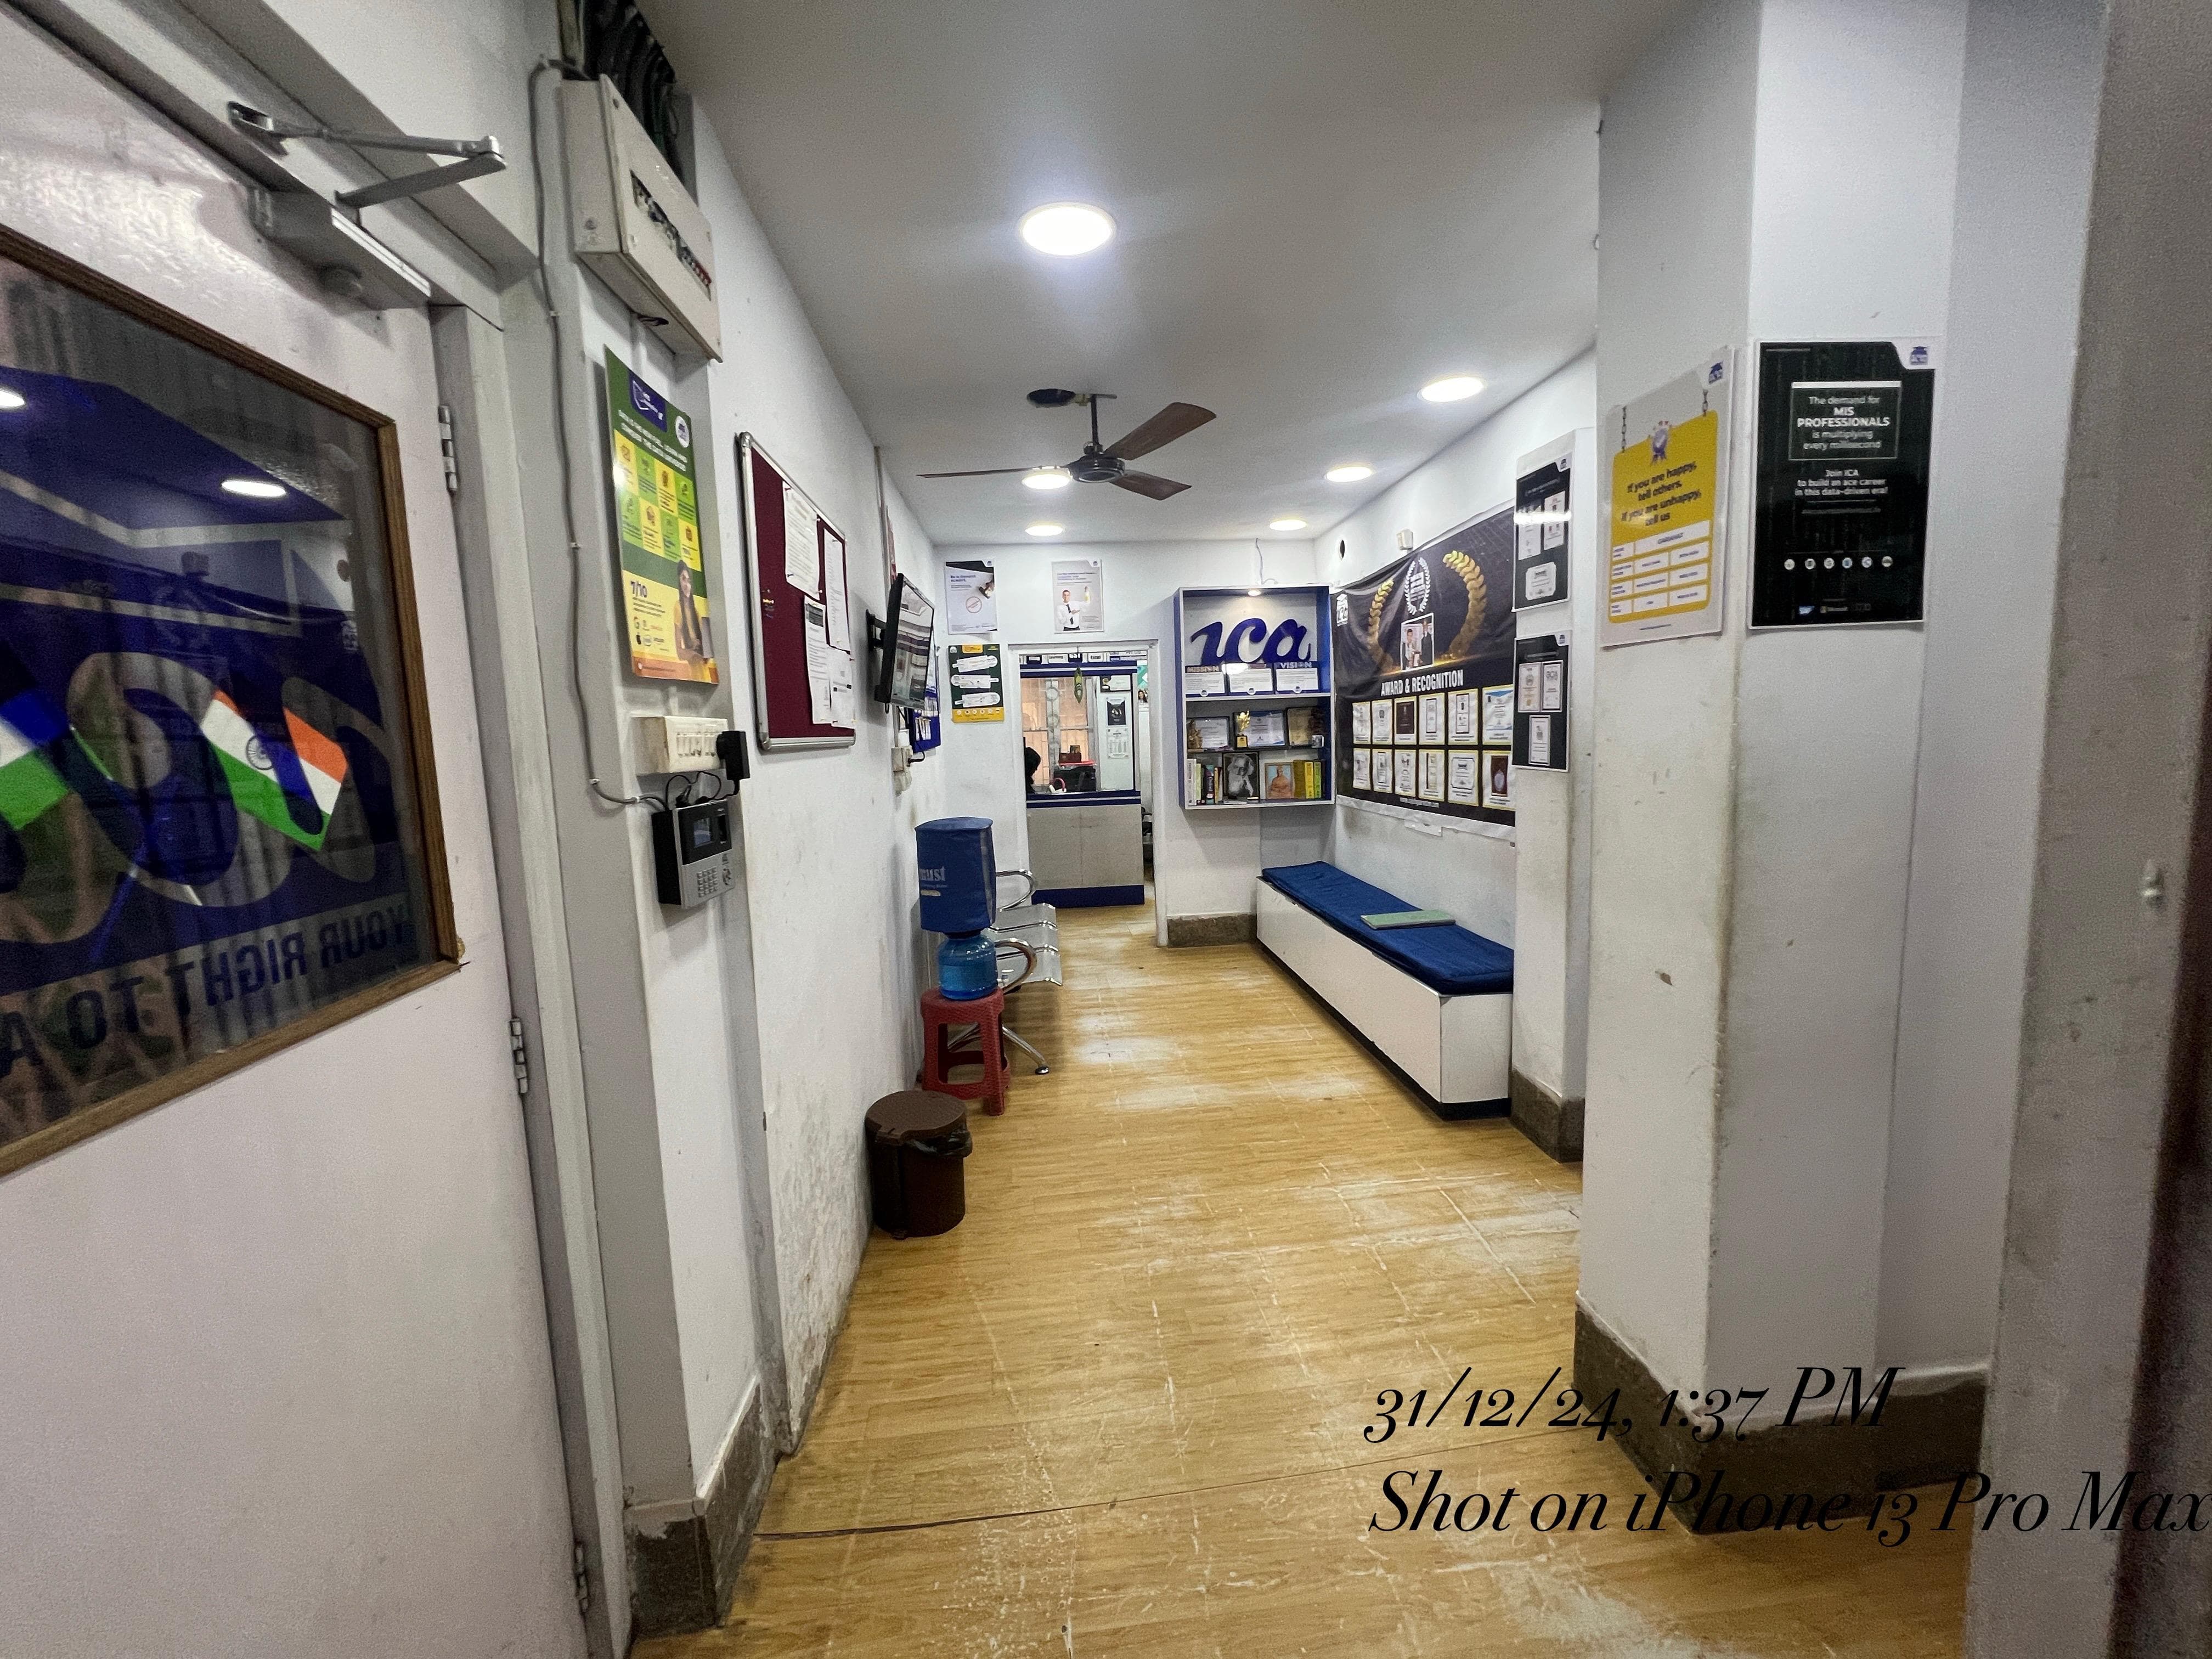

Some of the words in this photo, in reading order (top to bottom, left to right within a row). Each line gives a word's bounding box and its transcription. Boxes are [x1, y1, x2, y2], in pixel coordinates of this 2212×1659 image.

[1809, 396, 1826, 404] The
[1827, 396, 1865, 404] demand
[1867, 395, 1880, 404] for
[1833, 407, 1854, 416] MIS
[1797, 417, 1891, 427] PROFESSIONALS
[1803, 443, 1827, 451] every
[1829, 440, 1882, 449] millisecond
[1634, 479, 1650, 493] you
[1651, 473, 1665, 484] are
[1638, 489, 1651, 501] tell
[1645, 504, 1658, 514] are
[1646, 514, 1659, 526] tell
[1660, 512, 1671, 521] us
[1380, 679, 1403, 696] AWARD
[1404, 678, 1410, 693] &
[1412, 669, 1464, 692] RECOGNITION
